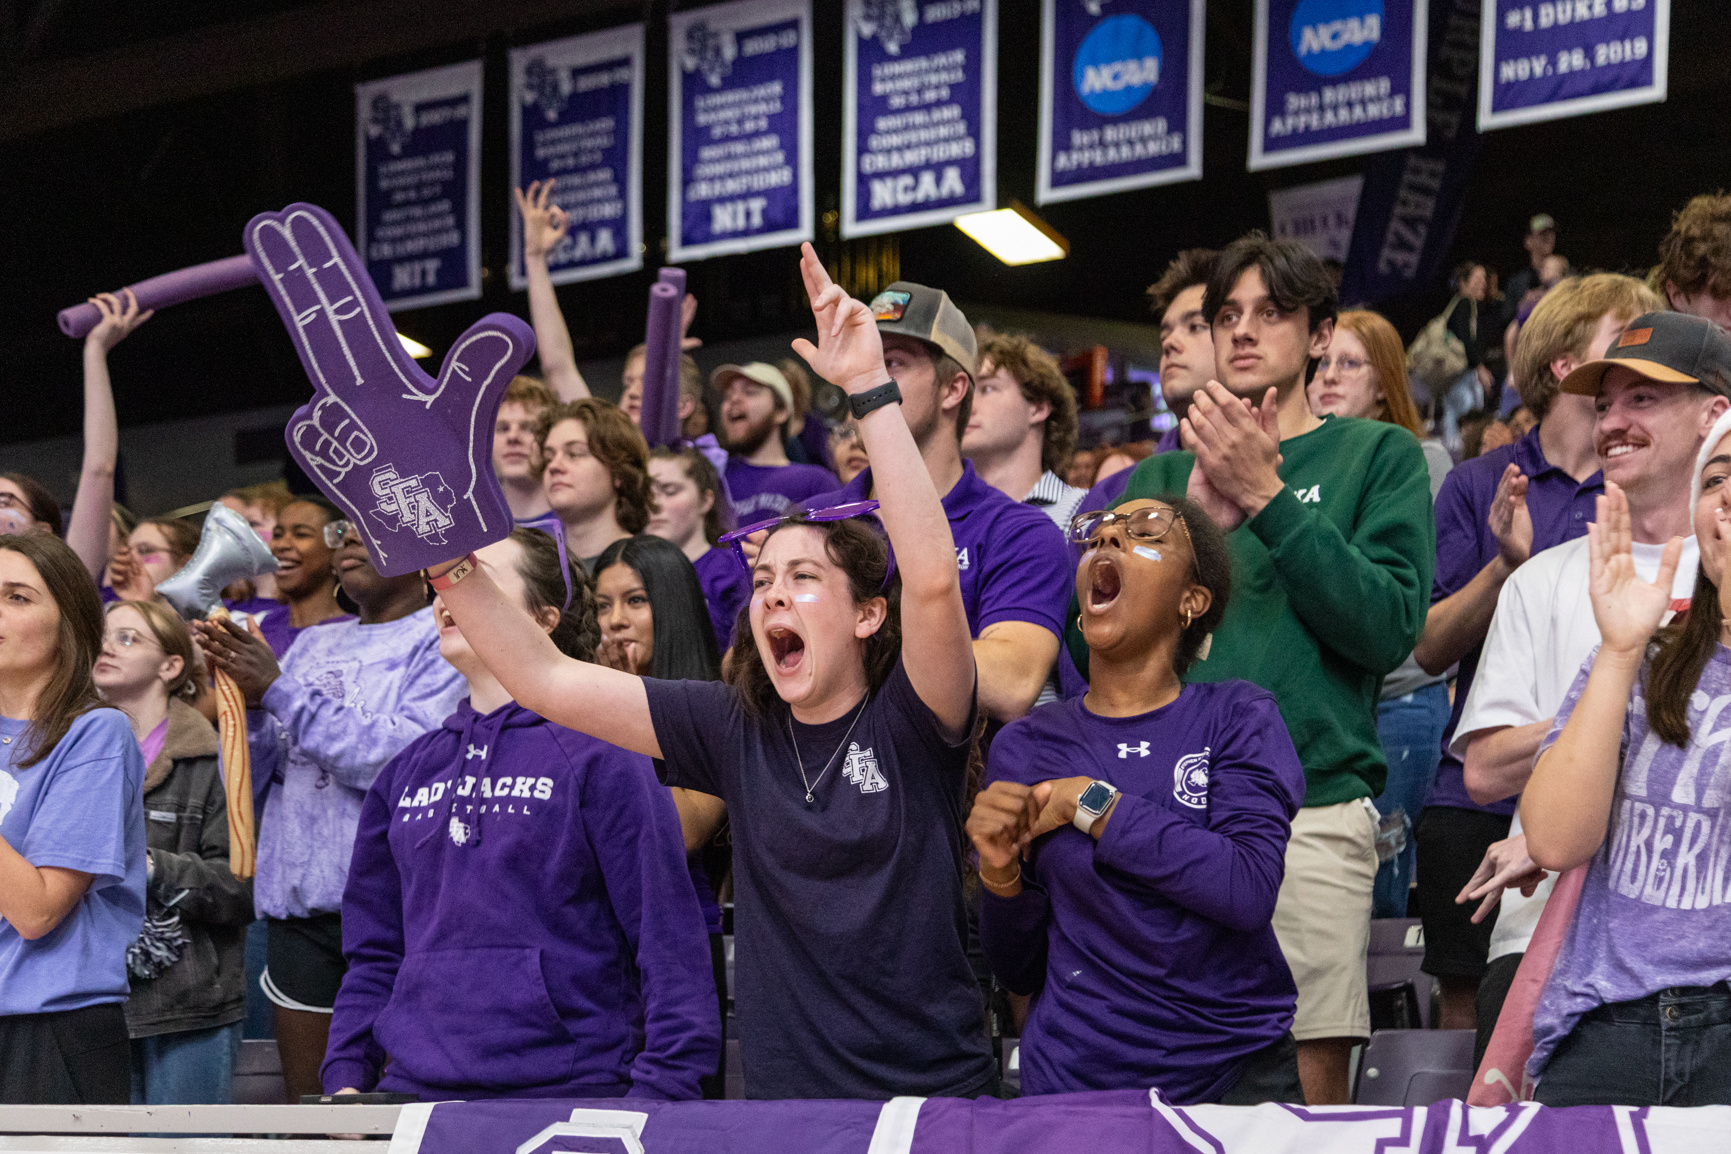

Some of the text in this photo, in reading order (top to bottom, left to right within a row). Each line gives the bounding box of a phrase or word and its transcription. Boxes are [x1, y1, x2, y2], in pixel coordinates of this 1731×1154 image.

[1297, 12, 1380, 58] NCAA
[1538, 0, 1608, 30] DUKE
[1081, 56, 1159, 96] NCAA
[1499, 54, 1553, 84] NOV.
[1595, 34, 1649, 68] 2019
[1321, 75, 1391, 106] ROUND
[1101, 115, 1168, 144] ROUND
[1268, 93, 1406, 139] APPEARANCE
[860, 136, 975, 175] CHAMPIONS
[1053, 132, 1183, 173] APPEARANCE
[684, 165, 793, 203] CHAMPIONS
[869, 165, 966, 212] NCAA
[710, 197, 768, 235] NIT
[546, 226, 617, 267] CAA
[369, 468, 455, 539] SFA
[842, 741, 889, 794] SFA
